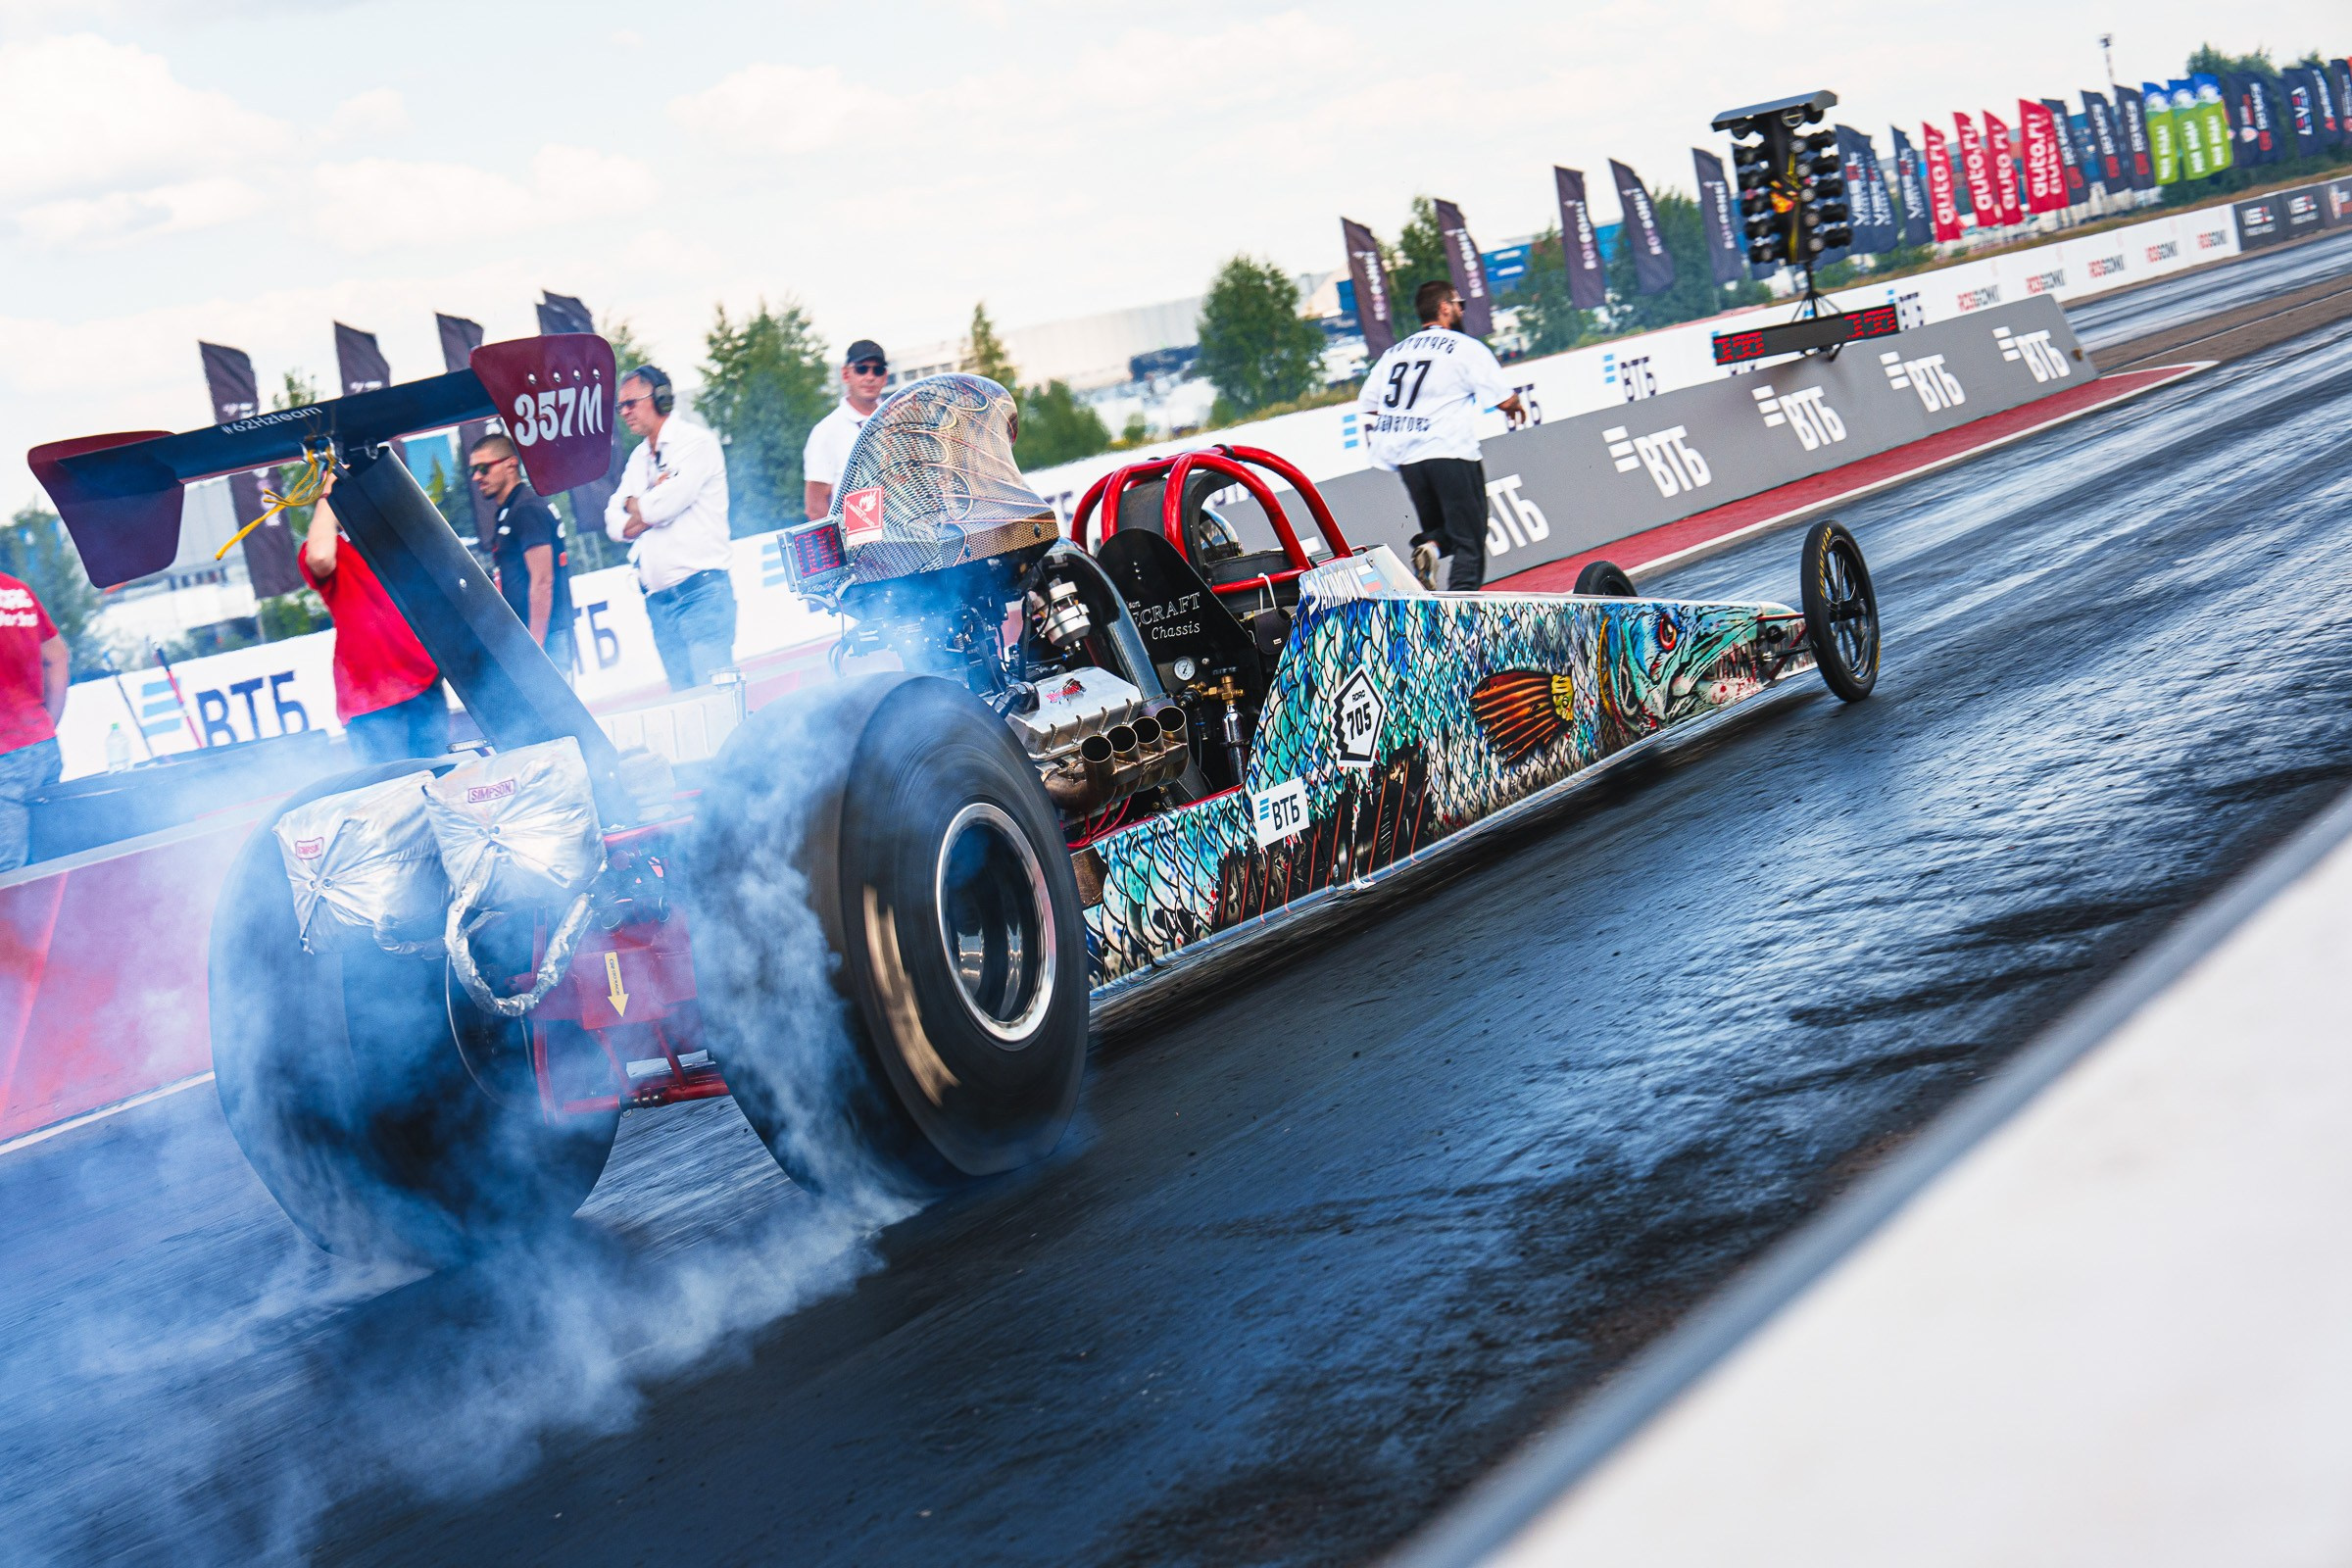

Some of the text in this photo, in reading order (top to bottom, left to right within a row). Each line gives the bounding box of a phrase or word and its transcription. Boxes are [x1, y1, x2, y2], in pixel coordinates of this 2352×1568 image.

[1927, 135, 1955, 225] autoru
[1992, 124, 2017, 211] autoru
[1385, 360, 1433, 410] 97
[1620, 356, 1657, 403] ВТБ
[1903, 354, 1966, 413] ВТБ
[2014, 329, 2071, 383] ВТБ
[514, 383, 606, 447] 357M
[1780, 385, 1847, 452] ВТБ
[1632, 424, 1712, 498] ВТБ
[1152, 620, 1200, 640] Chassis
[195, 670, 310, 748] ВТБ
[1347, 701, 1372, 741] 705
[1271, 793, 1300, 831] ВТБ
